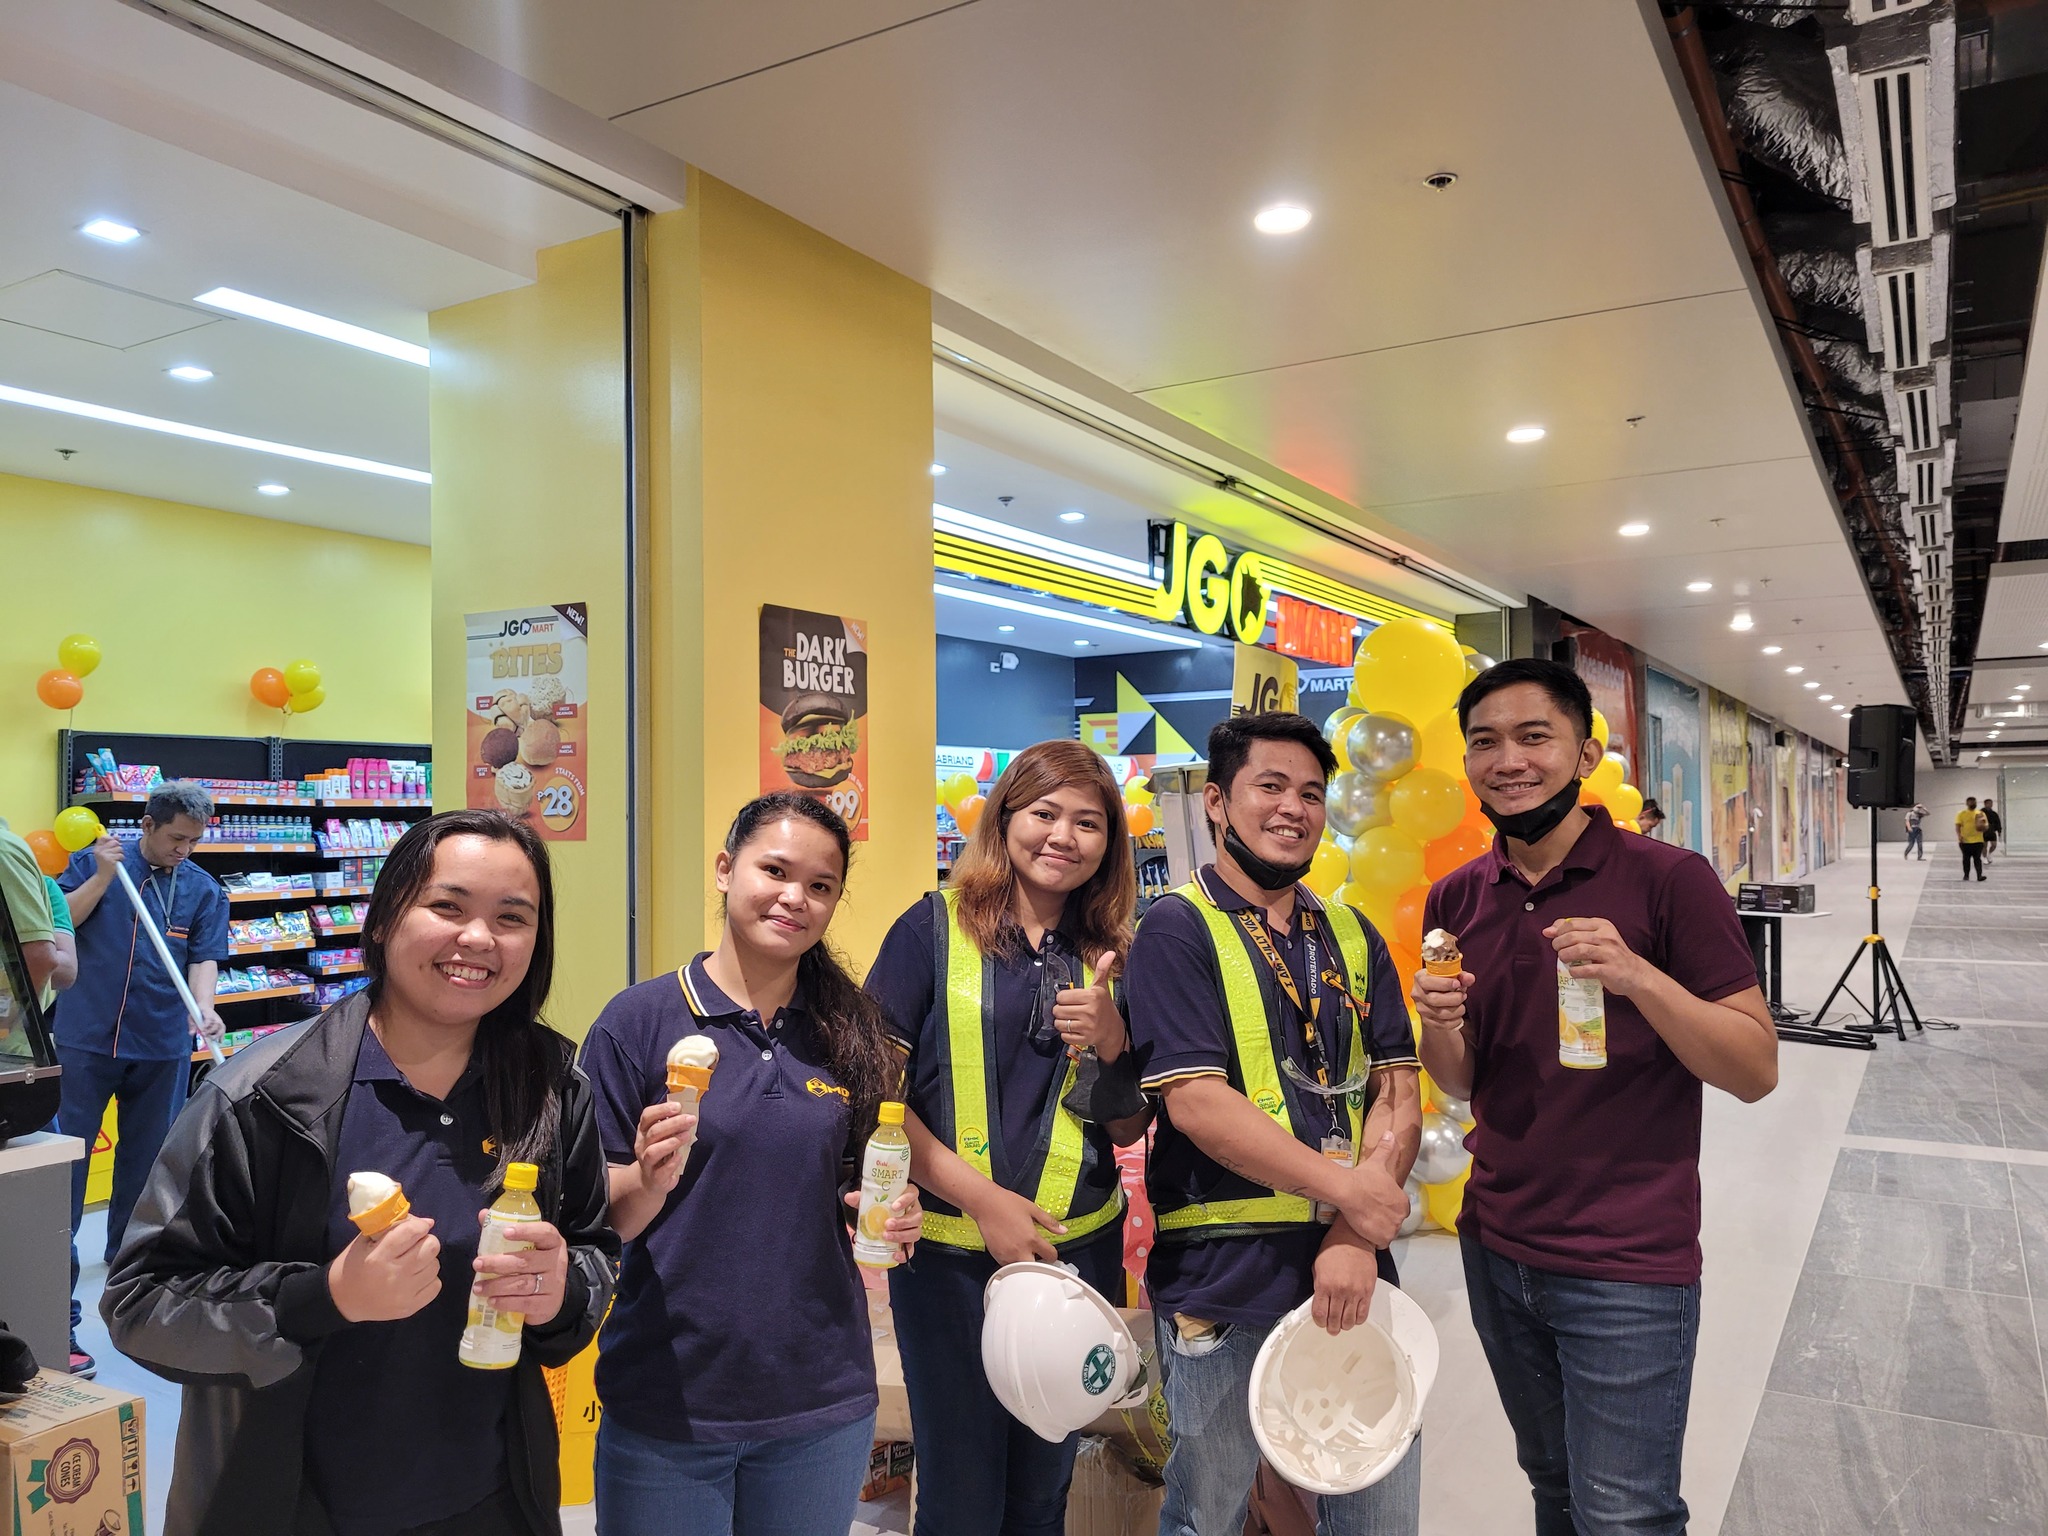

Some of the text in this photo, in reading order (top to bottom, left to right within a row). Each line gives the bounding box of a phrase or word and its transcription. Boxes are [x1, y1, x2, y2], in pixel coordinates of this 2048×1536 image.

[1153, 521, 1357, 667] JGO MART
[499, 619, 554, 637] JGO MART
[566, 606, 585, 626] NEW!
[490, 643, 563, 679] BITES
[784, 632, 846, 666] THE DARK
[783, 659, 856, 695] BURGER
[1310, 676, 1353, 693] MART
[555, 767, 585, 796] STARTS FROM
[871, 1168, 904, 1180] SMART
[882, 1180, 891, 1192] C
[60, 1461, 71, 1488] CONES
[72, 1451, 81, 1489] ICE CREAM
